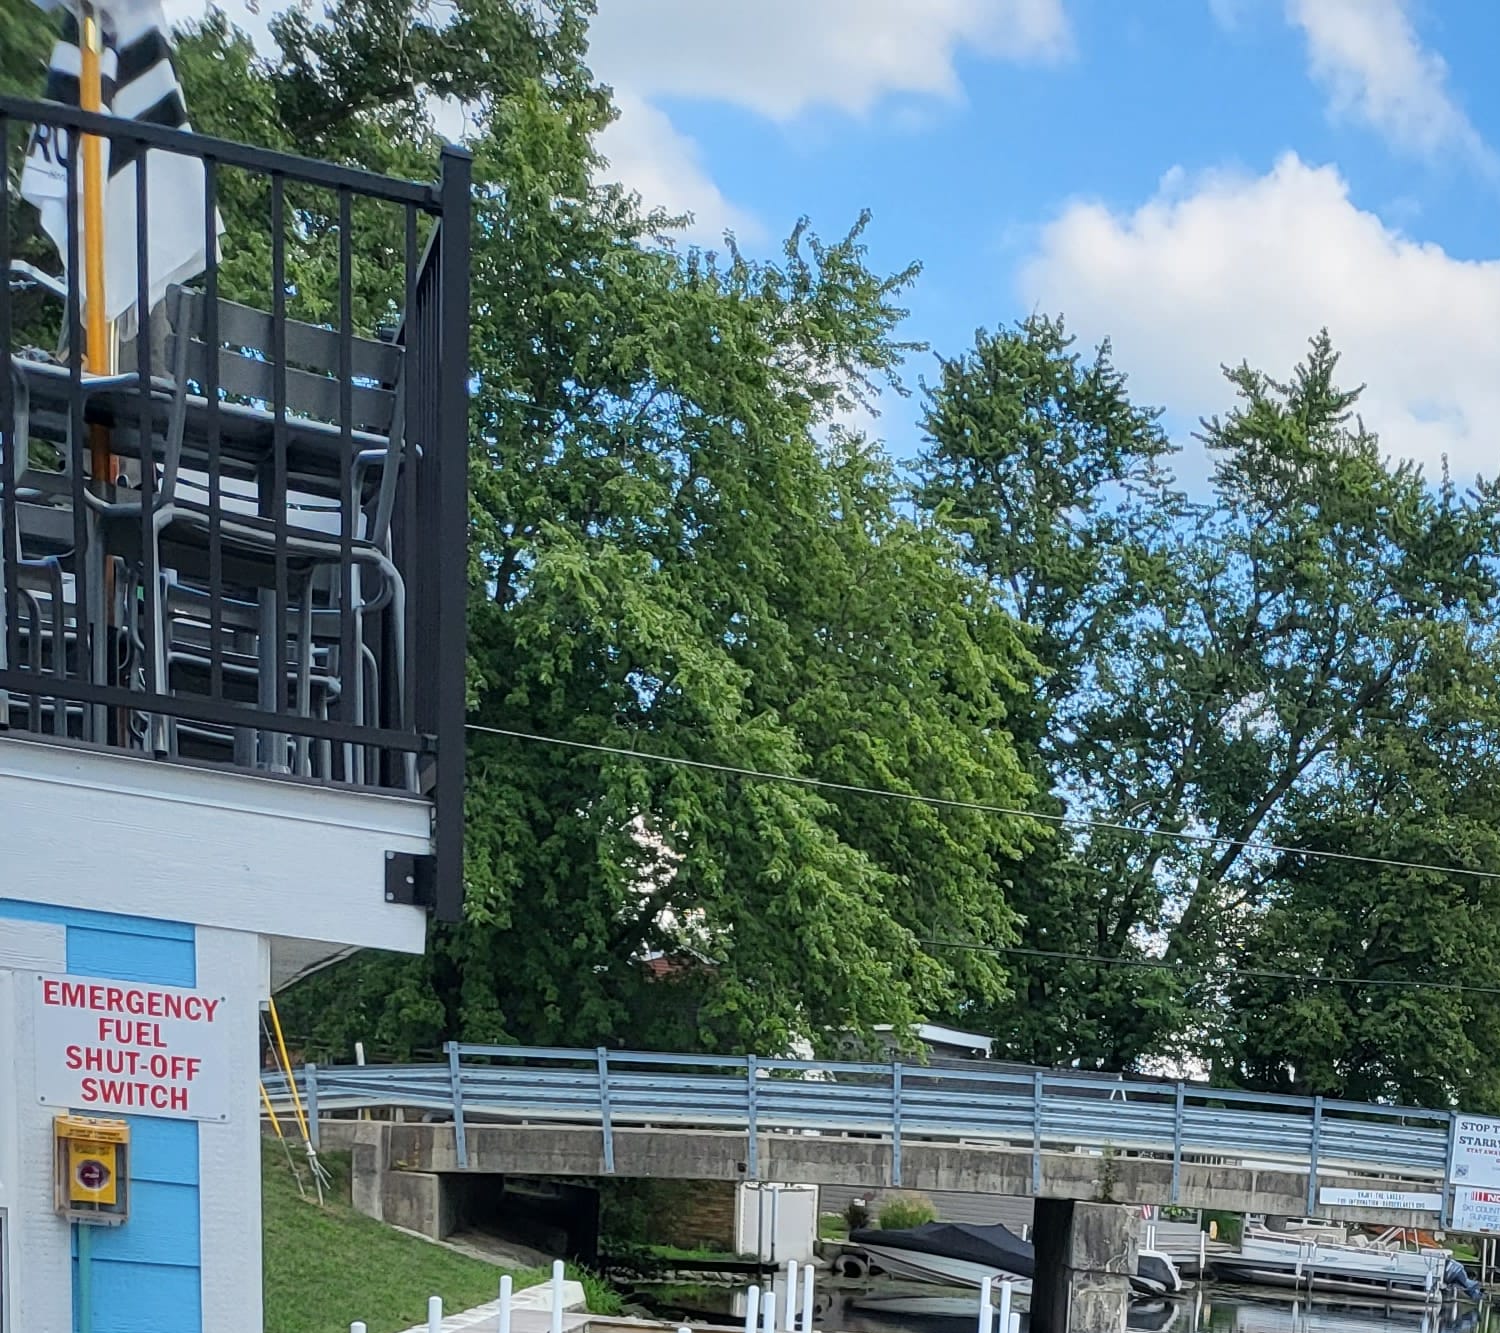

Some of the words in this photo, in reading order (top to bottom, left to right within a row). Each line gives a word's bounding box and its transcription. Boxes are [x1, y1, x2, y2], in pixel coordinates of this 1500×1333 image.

[43, 980, 219, 1022] EMERGENCY
[99, 1018, 167, 1048] FUEL
[65, 1045, 202, 1081] SHUT-OFF
[80, 1078, 189, 1111] SWITCH
[1460, 1122, 1490, 1133] STOP
